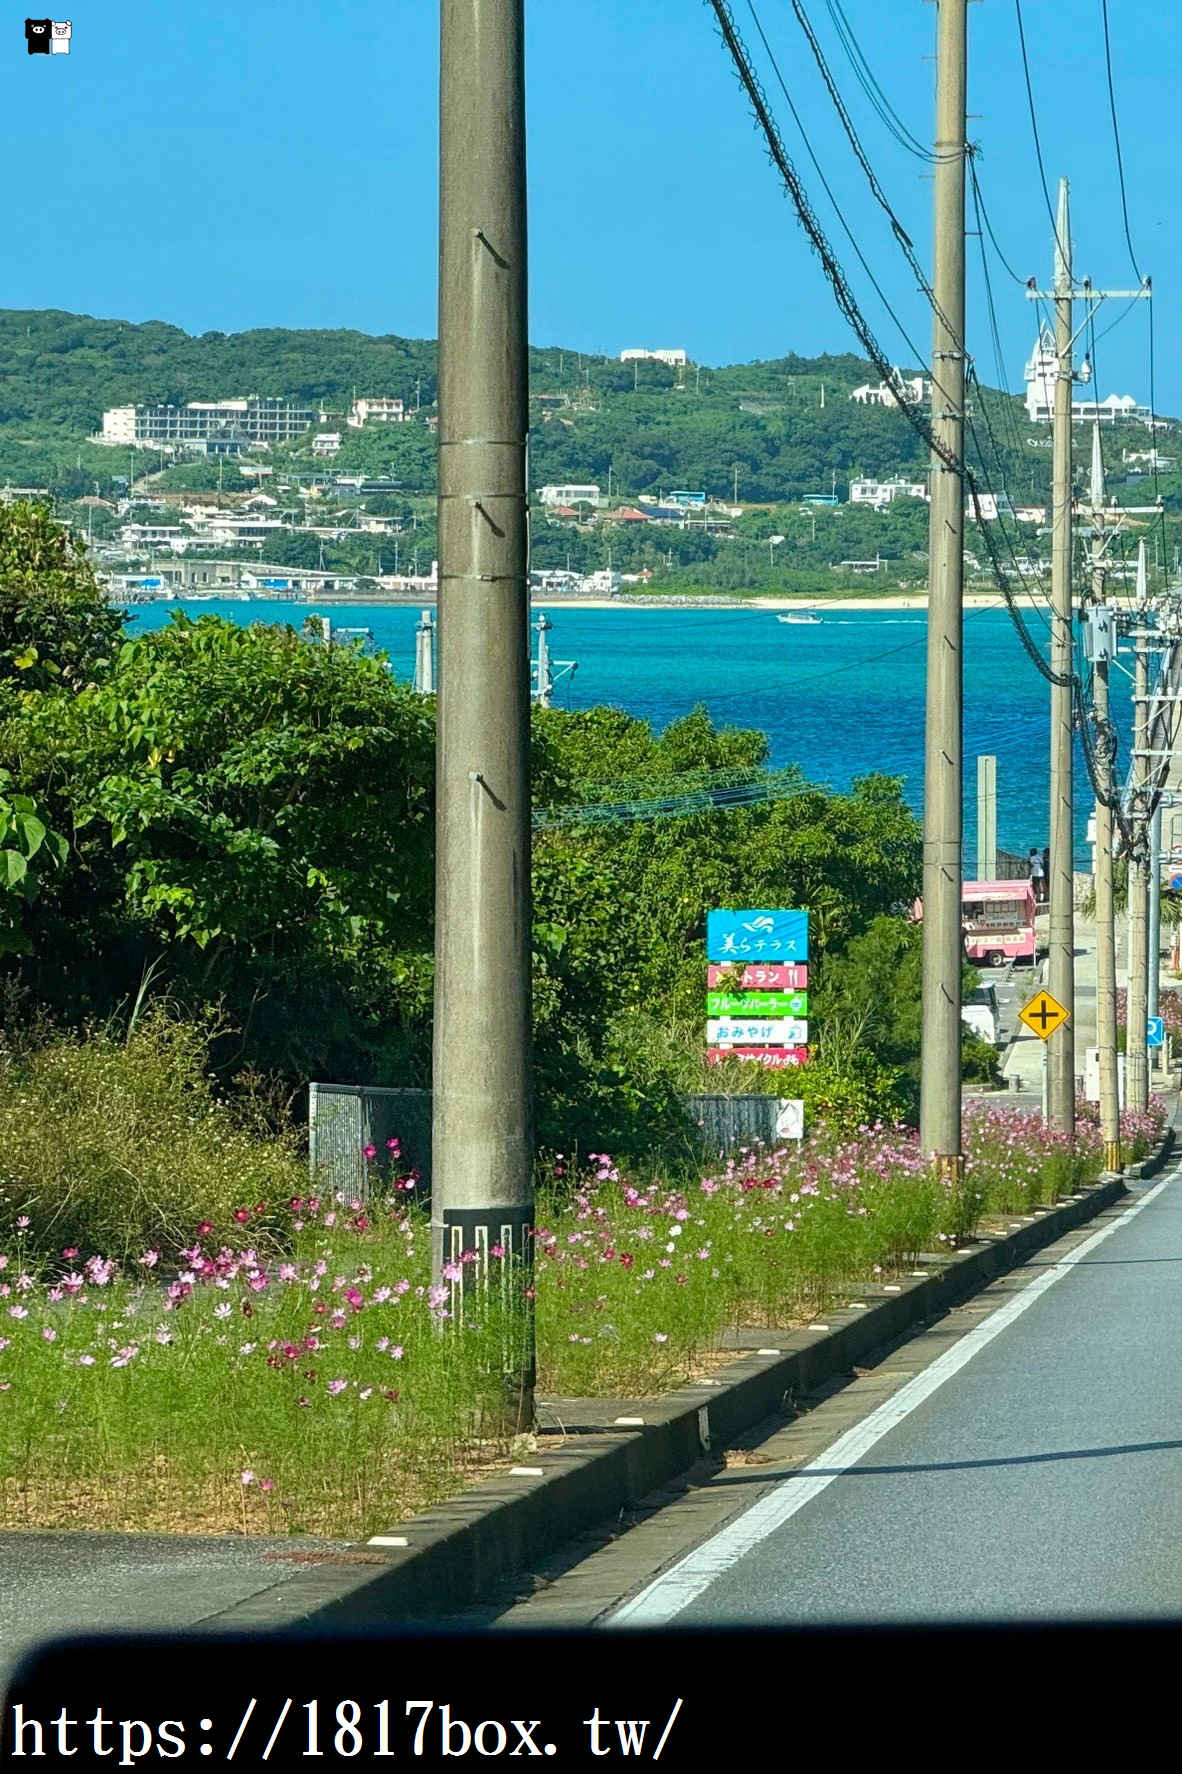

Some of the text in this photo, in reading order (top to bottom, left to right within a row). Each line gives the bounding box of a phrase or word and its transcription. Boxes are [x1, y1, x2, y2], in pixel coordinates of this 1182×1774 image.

[719, 932, 797, 954] 美らテラス
[716, 1025, 775, 1040] おみやげ
